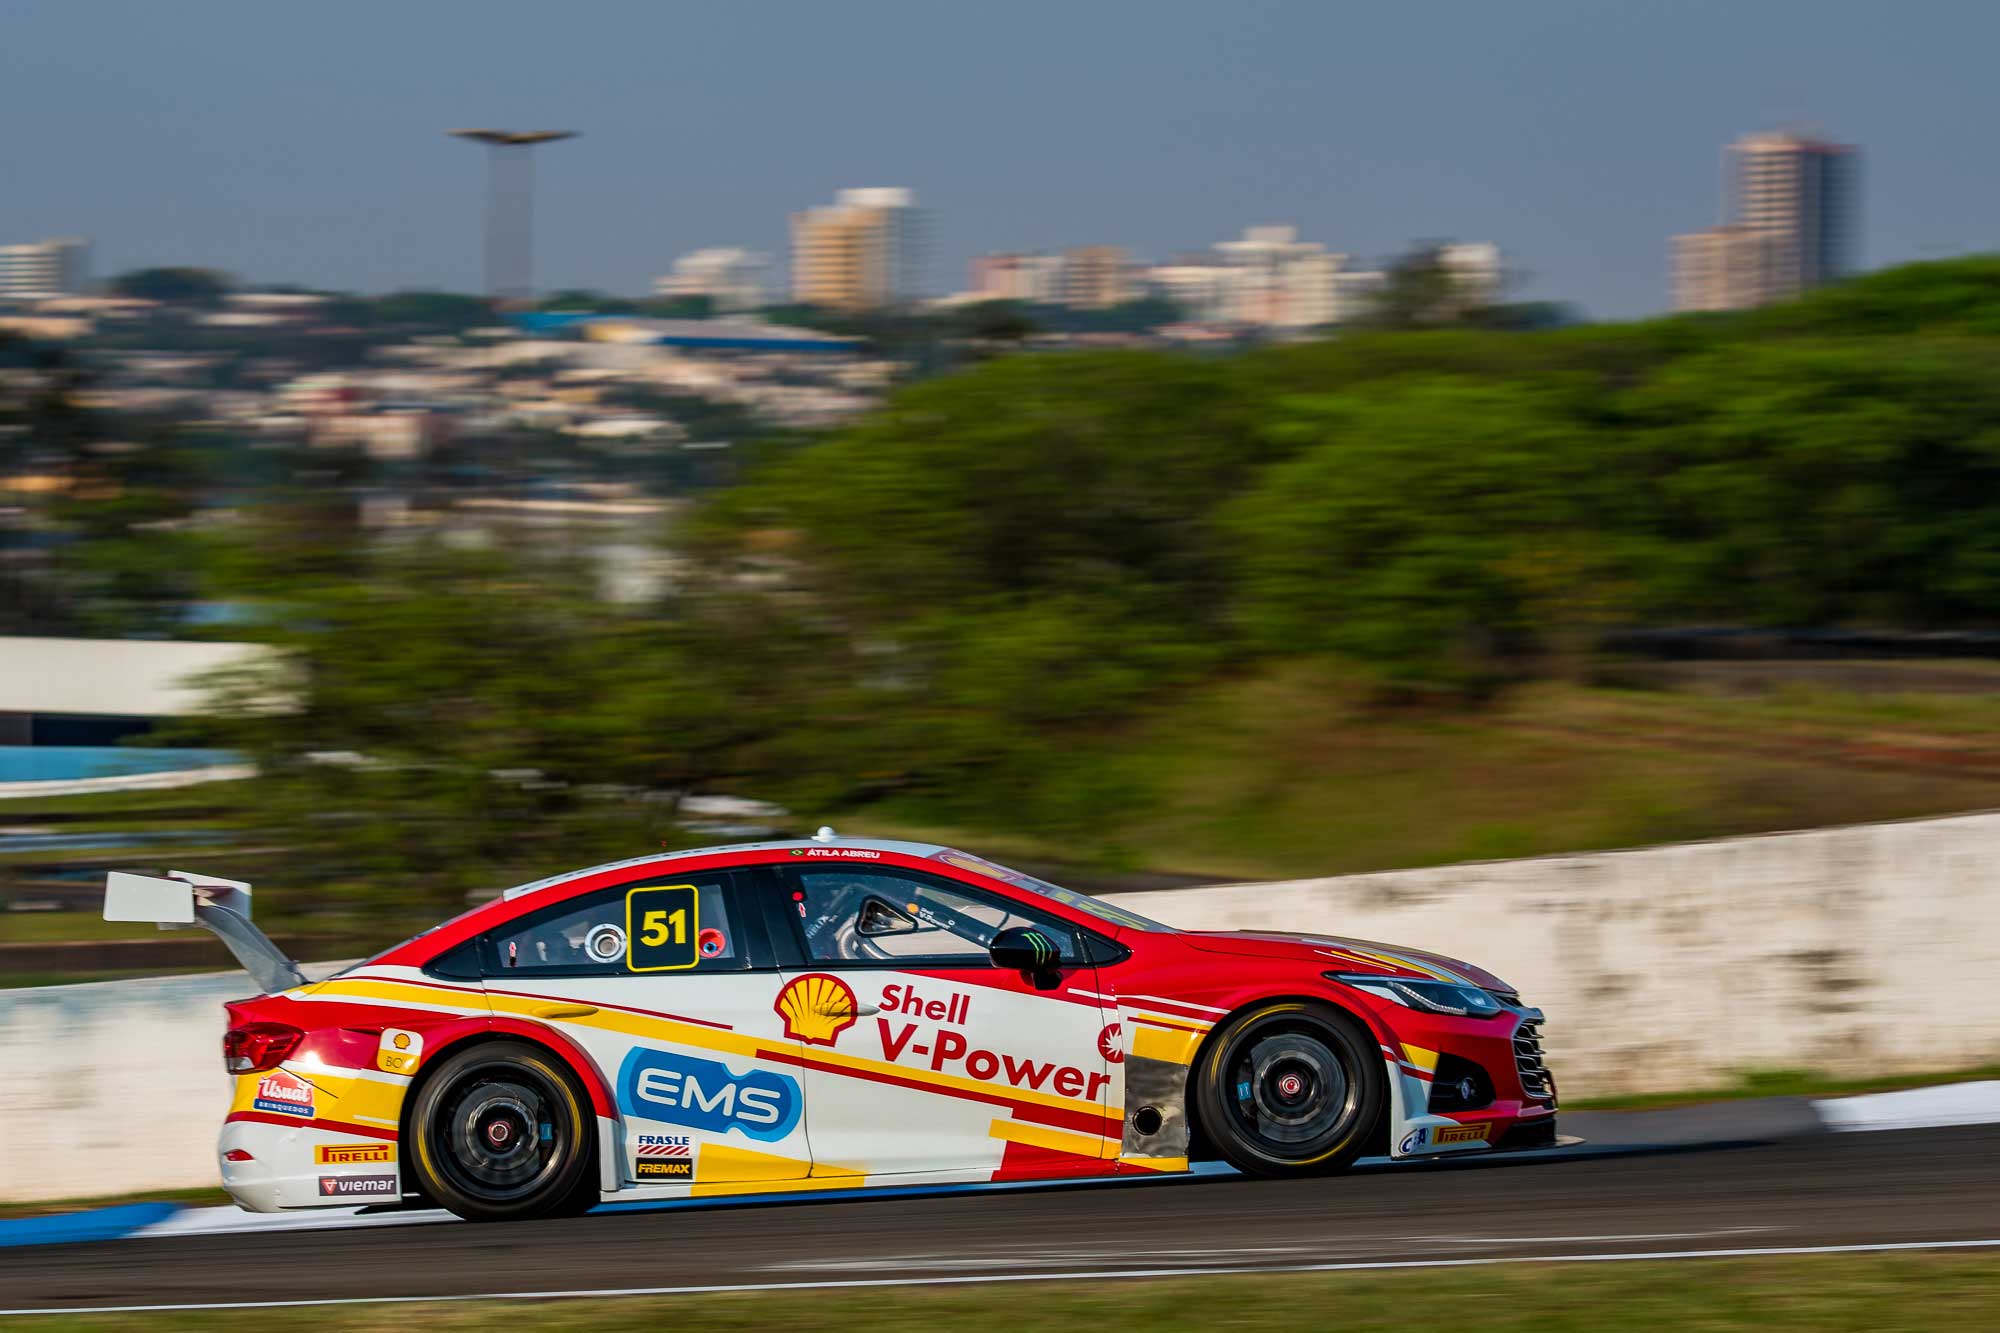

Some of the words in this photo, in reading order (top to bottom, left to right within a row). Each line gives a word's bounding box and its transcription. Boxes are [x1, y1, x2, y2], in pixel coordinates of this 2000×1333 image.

[841, 850, 880, 859] ABREU
[640, 909, 686, 947] 51
[878, 984, 970, 1025] Shell
[877, 1017, 1111, 1101] V-Power
[259, 1078, 312, 1103] Usual
[636, 1067, 781, 1124] EMS
[1438, 1125, 1486, 1143] PIRELLI
[322, 1145, 389, 1162] PIRELLI
[638, 1163, 690, 1174] FREMAX
[338, 1180, 395, 1191] viemar
